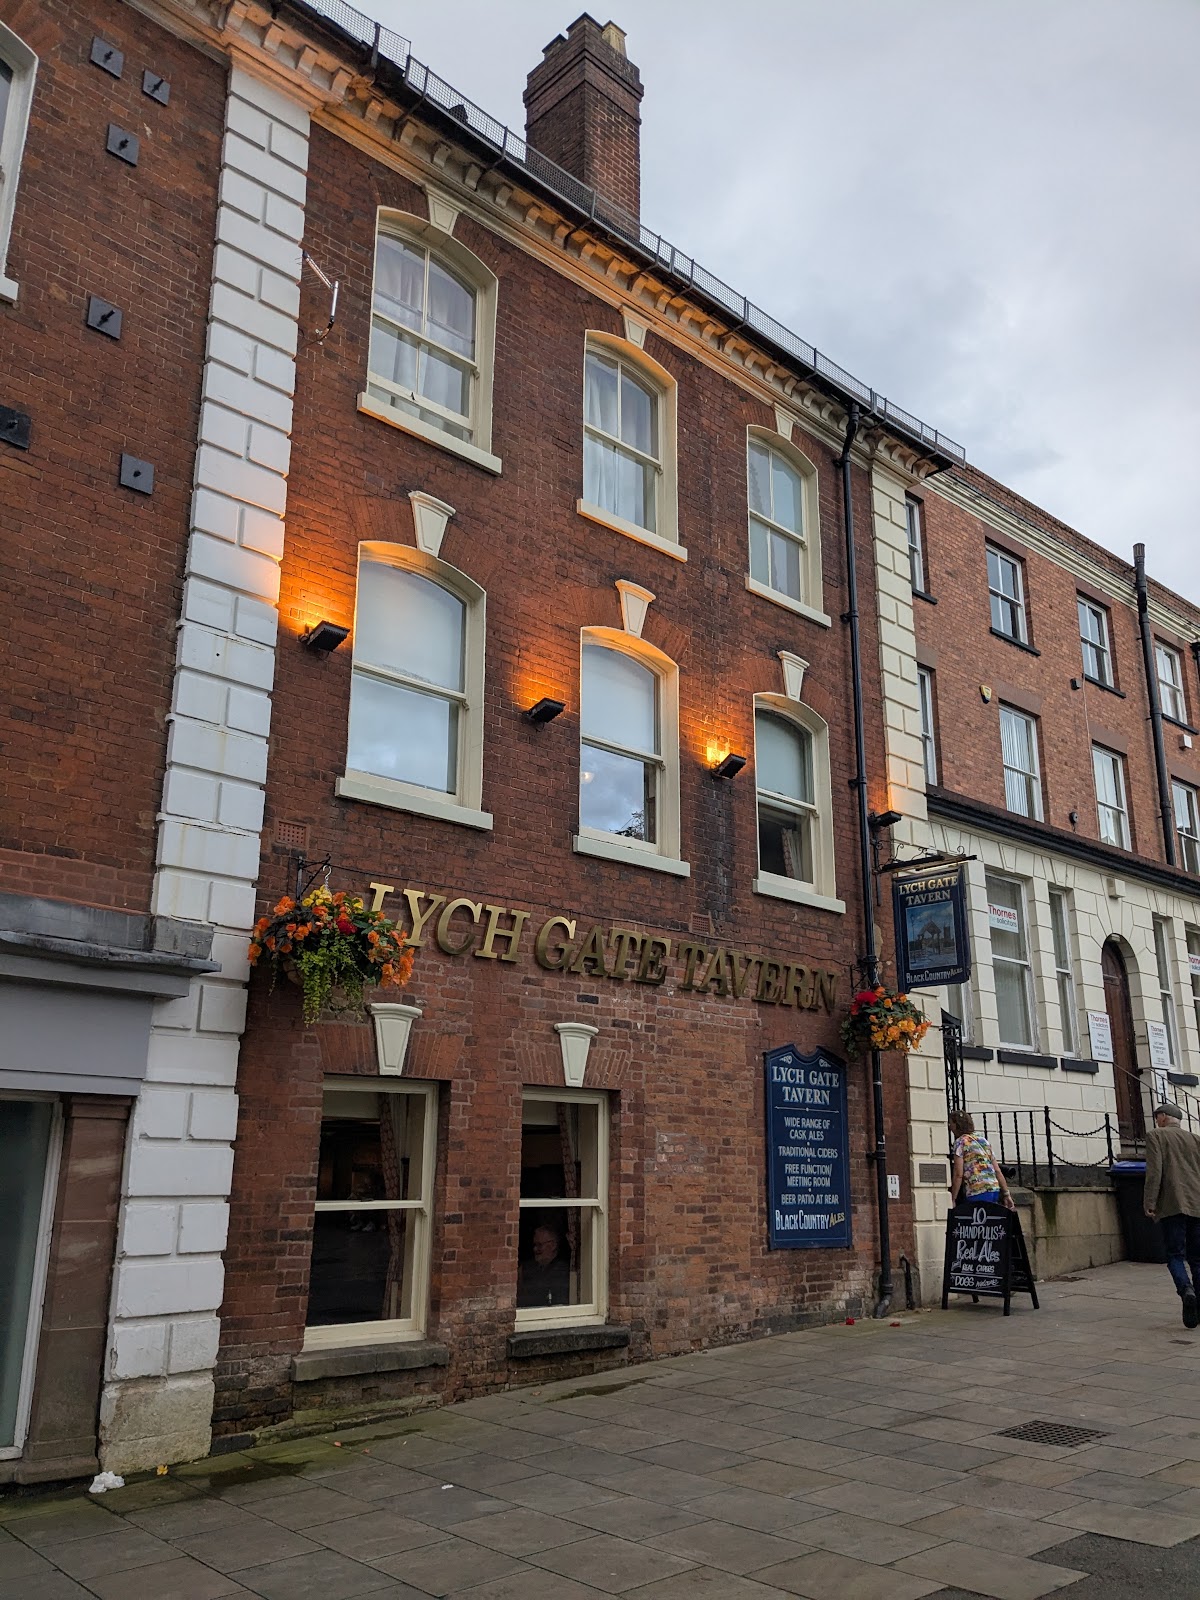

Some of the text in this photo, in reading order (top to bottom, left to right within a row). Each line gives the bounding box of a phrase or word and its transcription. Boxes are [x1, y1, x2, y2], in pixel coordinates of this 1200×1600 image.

[899, 875, 959, 895] LYCH GATE
[905, 889, 951, 907] TAVERN
[987, 903, 1017, 921] Thornes
[996, 917, 1018, 928] solicitors
[536, 915, 671, 985] GATE
[678, 941, 840, 1014] TAVERN
[1090, 1013, 1108, 1024] Thornes
[772, 1065, 840, 1088] LYCH GATE
[782, 1086, 831, 1105] TAVERN
[784, 1116, 831, 1130] WIDE RANGE OF
[789, 1129, 824, 1142] CASK ALES
[778, 1145, 838, 1159] TRADITIONAL CIDERS
[785, 1163, 833, 1176] FREE FUNCTION/
[787, 1175, 831, 1188] MEETING ROOM
[781, 1193, 839, 1205] BEER PATIO AT REAR
[970, 1207, 987, 1225] 10
[956, 1239, 1001, 1263] Real Ales
[955, 1275, 975, 1287] DOGS
